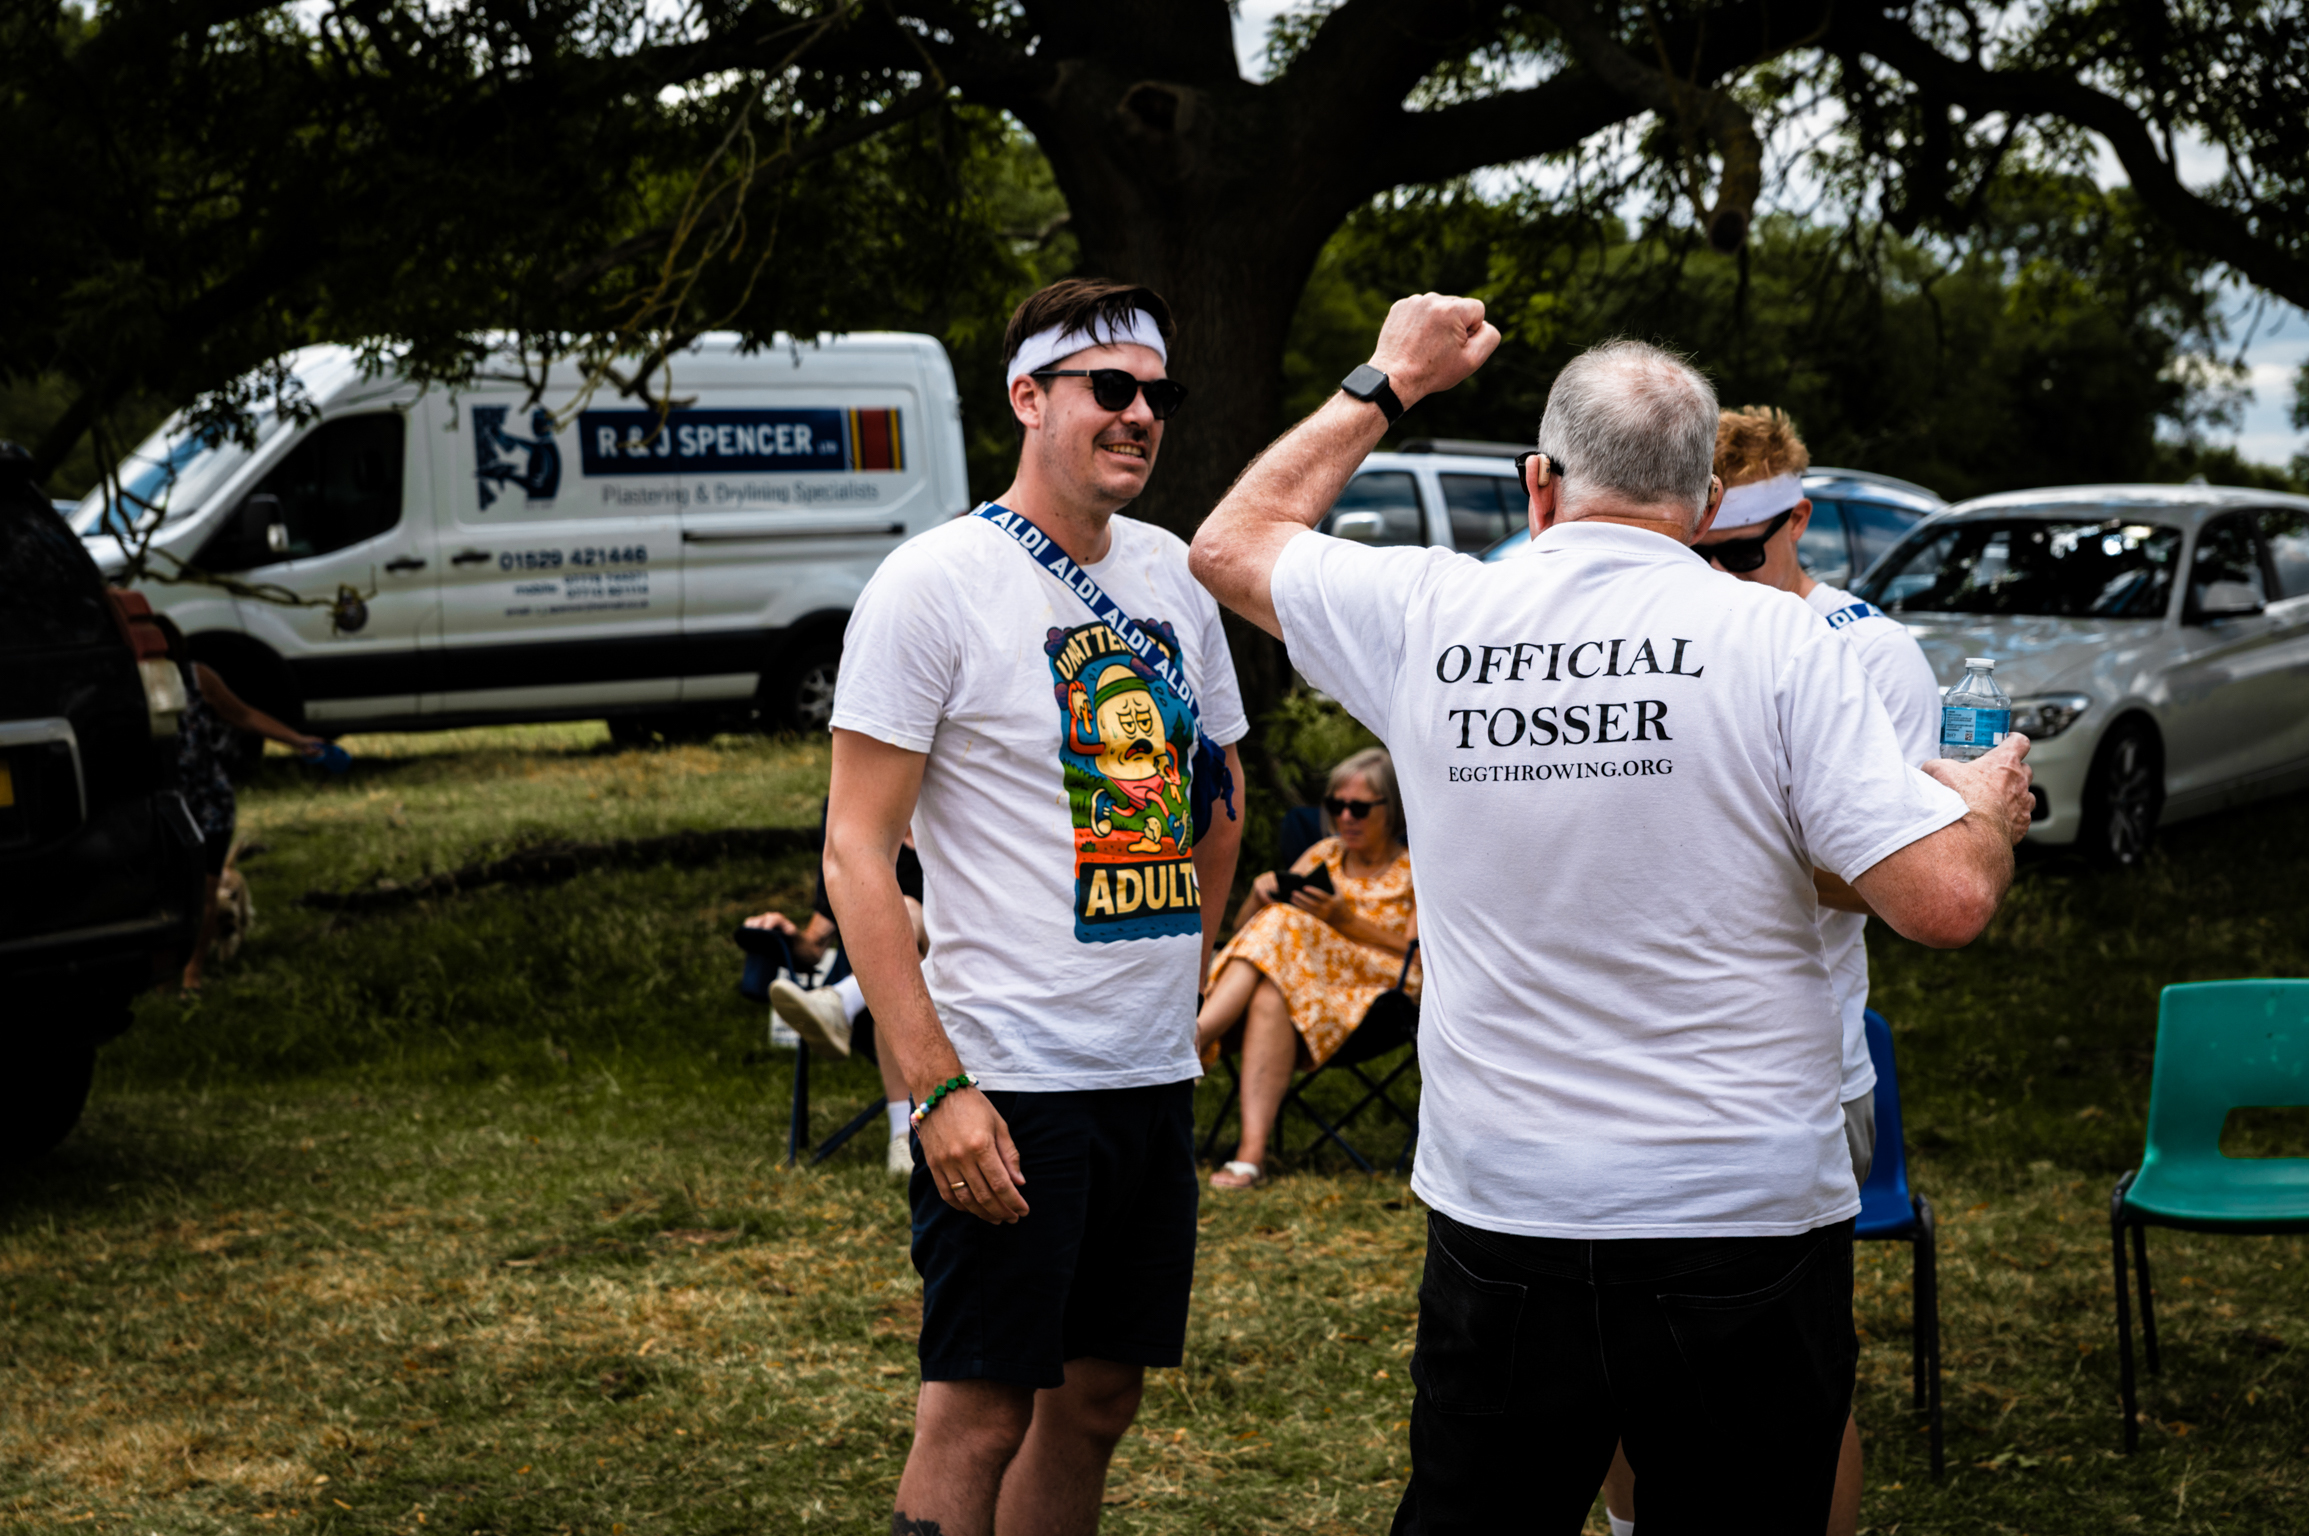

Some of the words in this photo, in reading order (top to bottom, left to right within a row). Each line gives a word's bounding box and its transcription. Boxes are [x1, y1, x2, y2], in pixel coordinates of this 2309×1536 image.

[597, 426, 618, 457] R
[627, 425, 650, 457] &
[655, 425, 671, 456] J
[677, 424, 813, 456] SPENCER
[603, 484, 690, 507] Plastering
[696, 484, 710, 502] &
[716, 482, 790, 507] Drylining
[793, 480, 879, 505] Specialists
[990, 511, 1051, 557] ALDI
[1047, 556, 1103, 607] ALDI
[1101, 607, 1152, 658] ALDI
[1153, 658, 1195, 709] ALDI
[1436, 637, 1704, 684] OFFICIAL
[1448, 700, 1673, 749] TOSSER
[1449, 759, 1673, 782] EGGTHROWING.ORG
